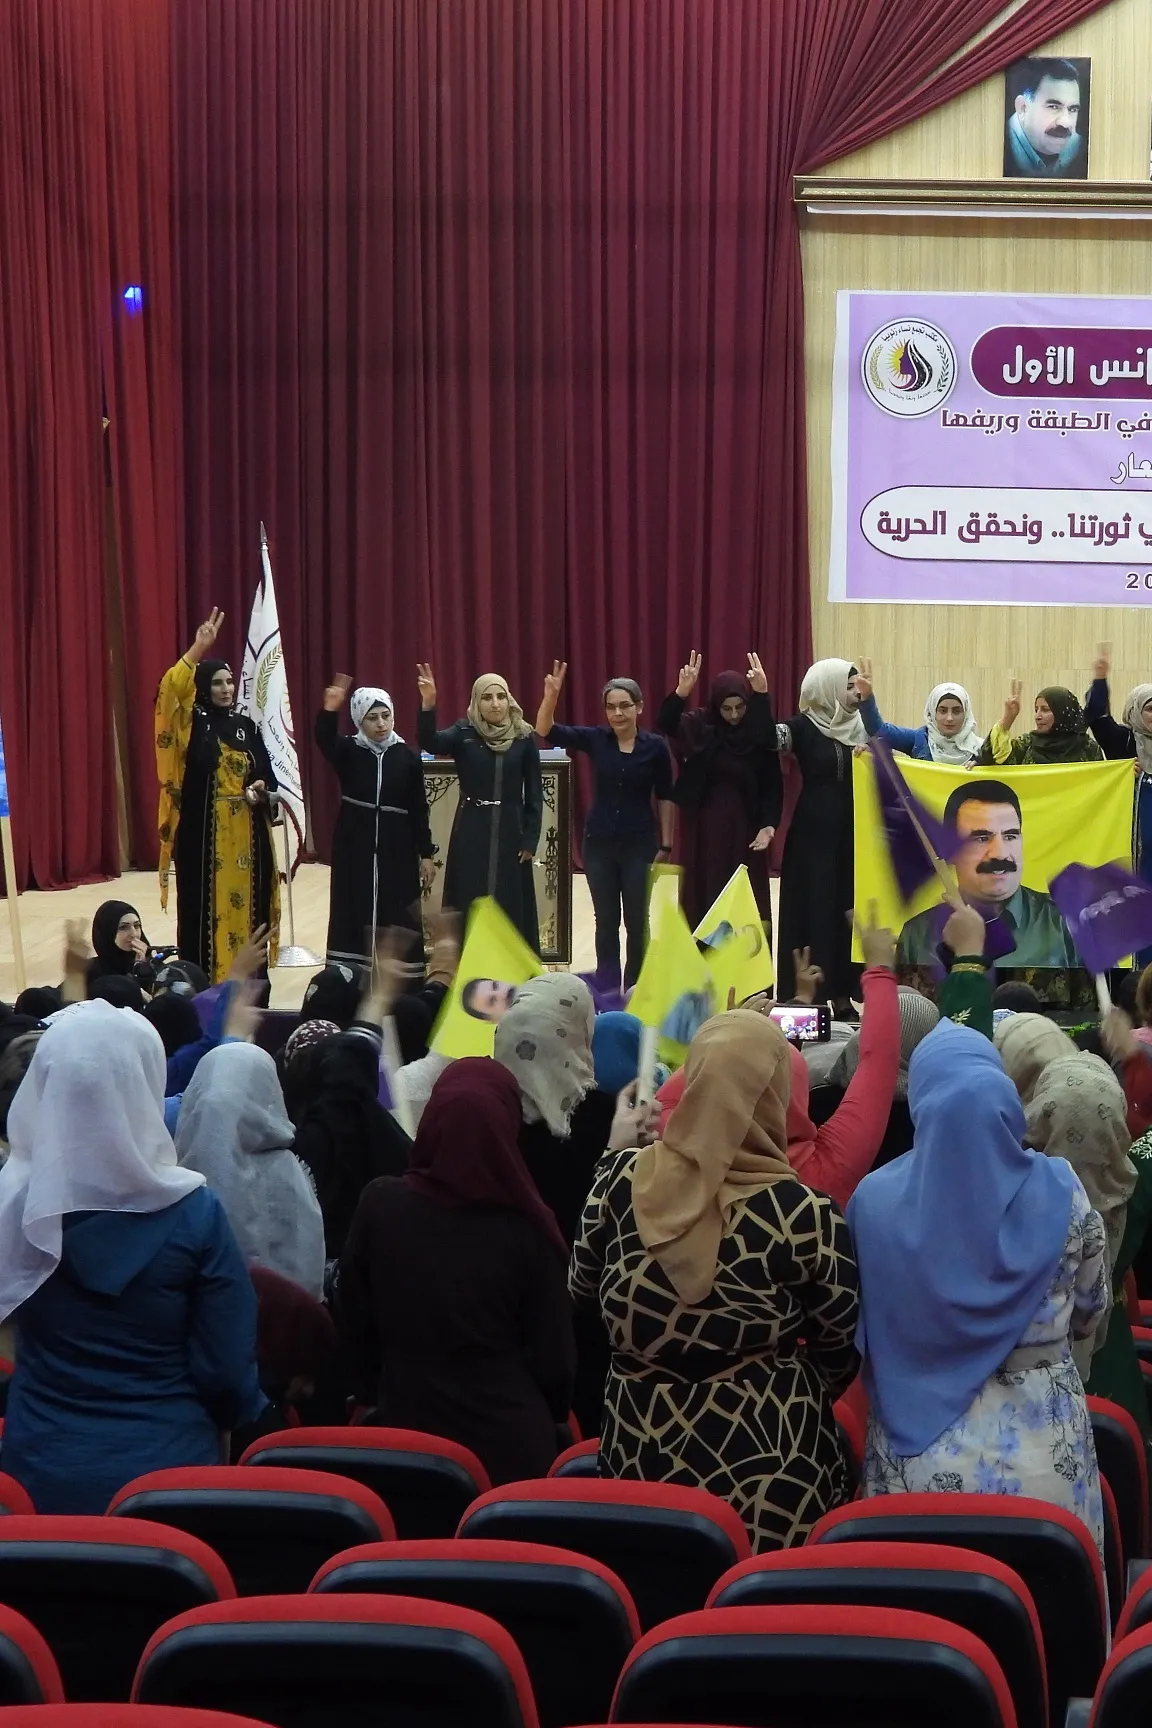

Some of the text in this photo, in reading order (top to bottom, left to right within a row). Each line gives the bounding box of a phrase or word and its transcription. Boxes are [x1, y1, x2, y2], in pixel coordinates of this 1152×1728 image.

[881, 328, 898, 342] زنوبيا
[899, 324, 911, 333] نساء
[911, 326, 925, 335] تجمع
[1002, 344, 1075, 385] الأول
[941, 408, 1020, 435] وريفها
[1027, 409, 1111, 436] الطبقة
[1116, 412, 1152, 439] في
[876, 510, 947, 542] الحرية
[957, 511, 1043, 545] ونحقق
